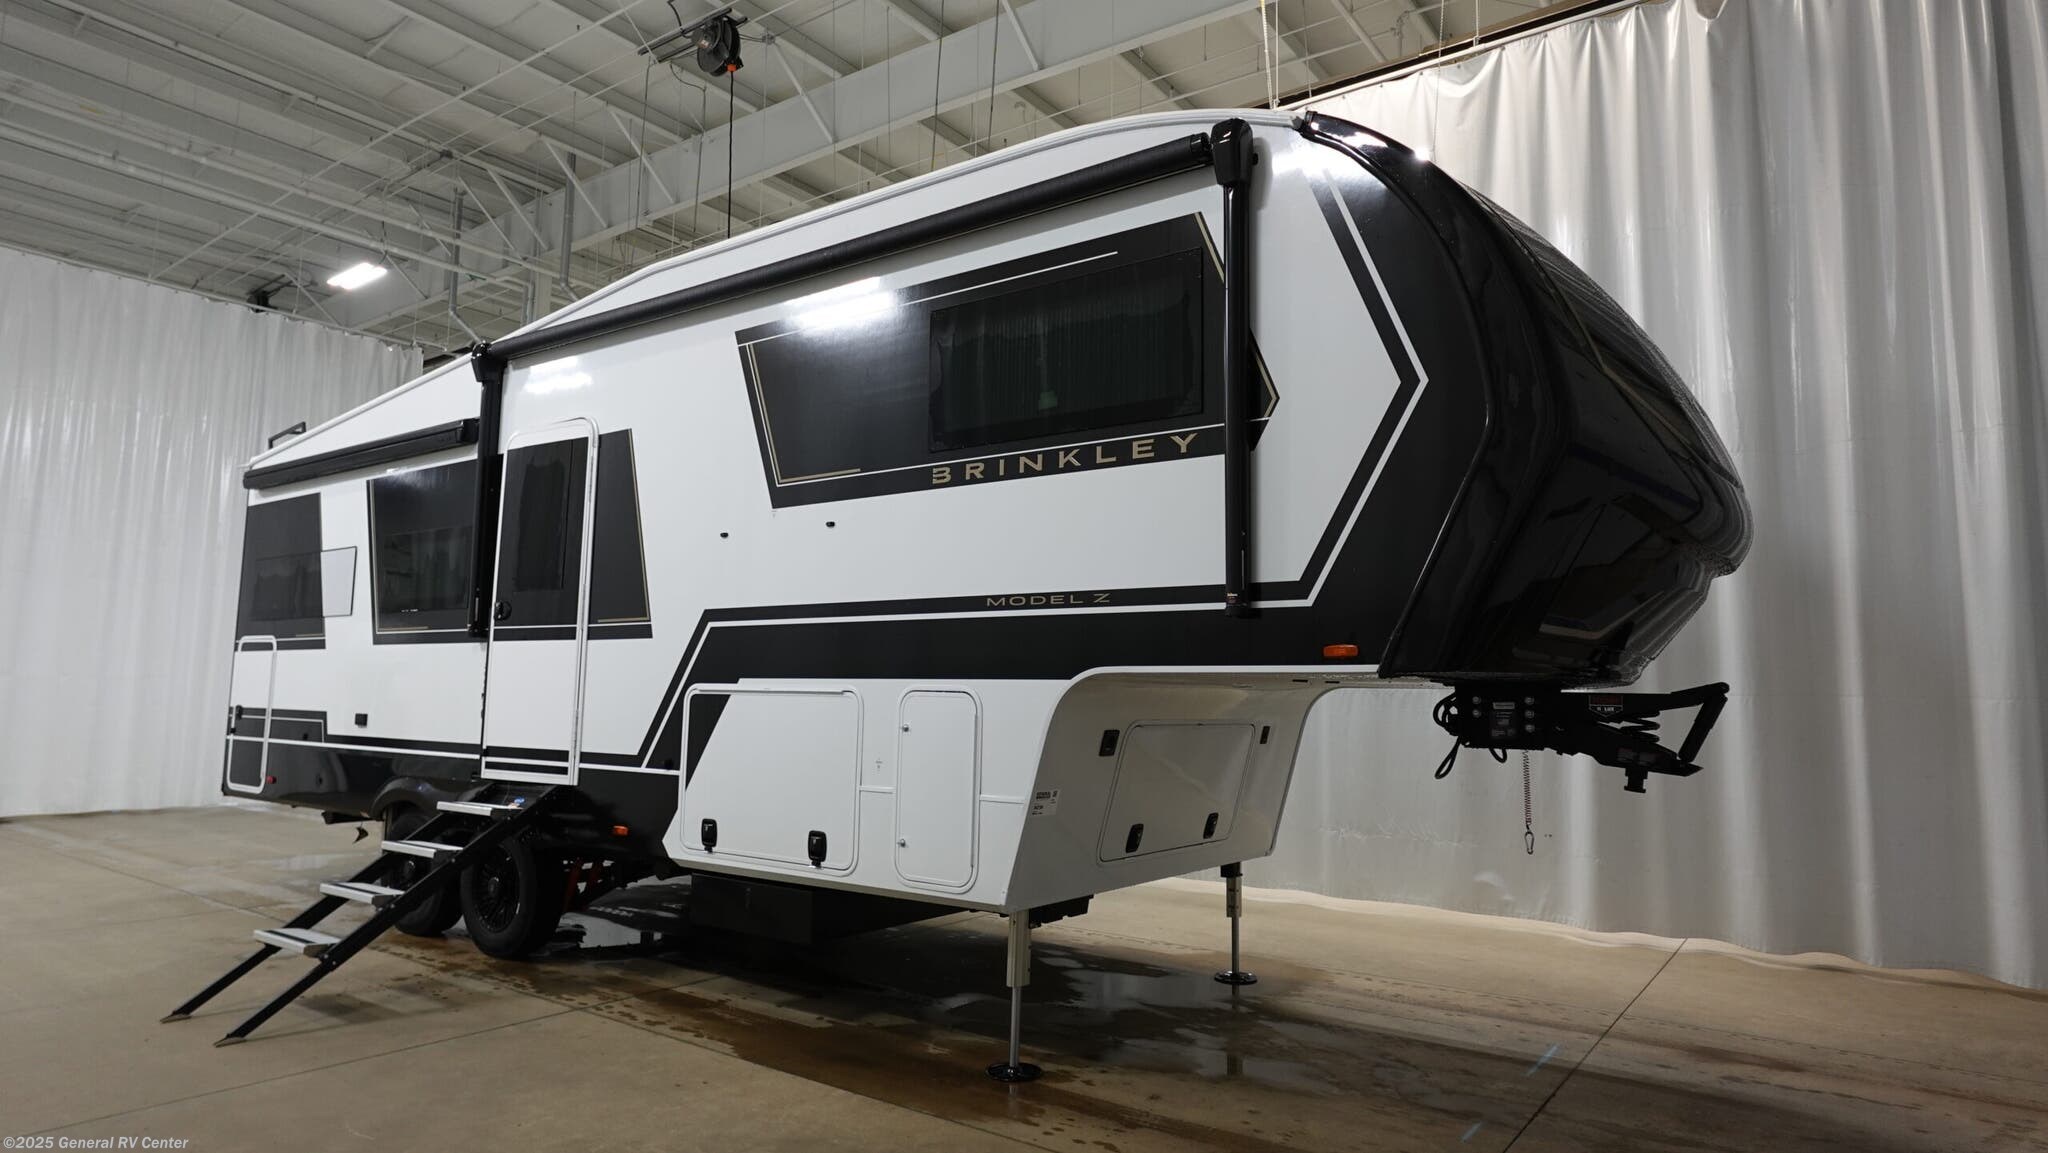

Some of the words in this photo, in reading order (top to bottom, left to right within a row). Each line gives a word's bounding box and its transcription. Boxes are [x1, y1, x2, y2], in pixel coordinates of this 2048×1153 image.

[932, 432, 1198, 485] BRINKLEY
[986, 594, 1083, 607] MODEL
[1092, 592, 1110, 603] Z
